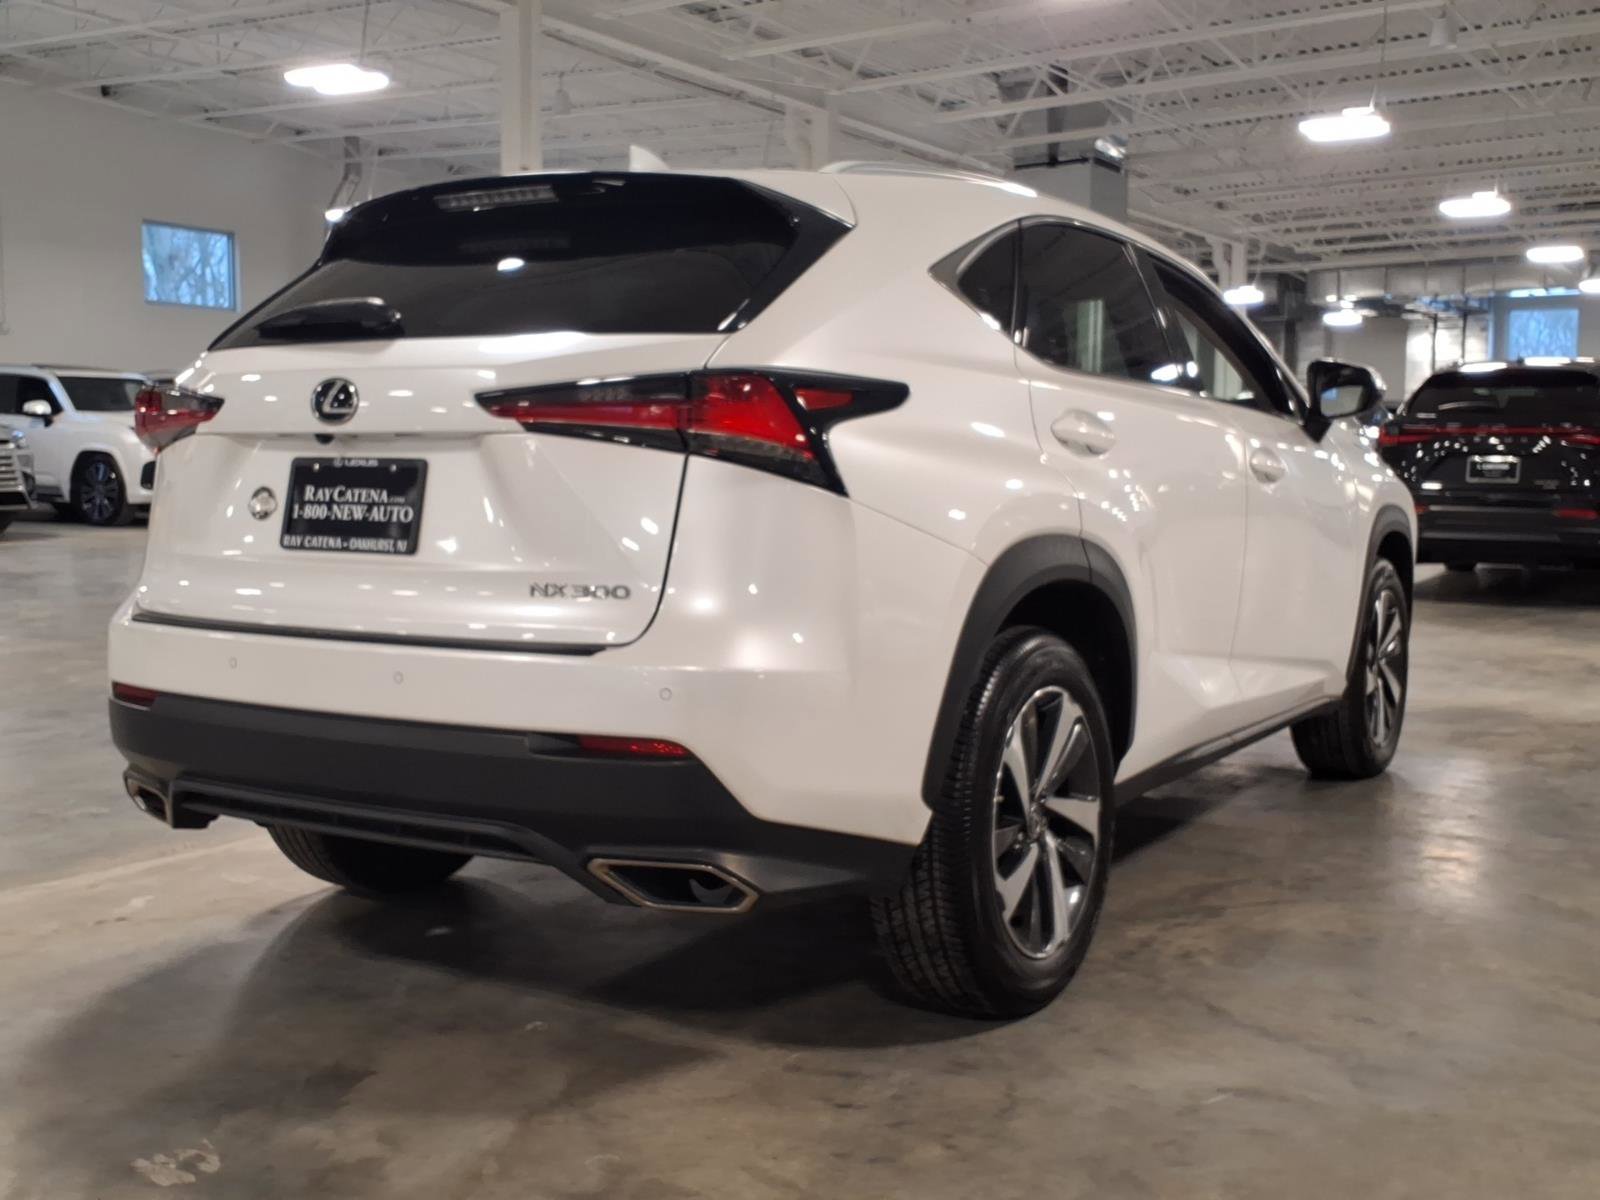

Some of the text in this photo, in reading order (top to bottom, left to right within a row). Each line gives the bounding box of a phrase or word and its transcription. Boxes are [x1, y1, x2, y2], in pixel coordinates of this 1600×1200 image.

[293, 504, 414, 523] 1-800-NEW-AUTO
[282, 534, 302, 548] RAY
[303, 535, 343, 549] CATENA
[529, 582, 631, 599] NX 300
